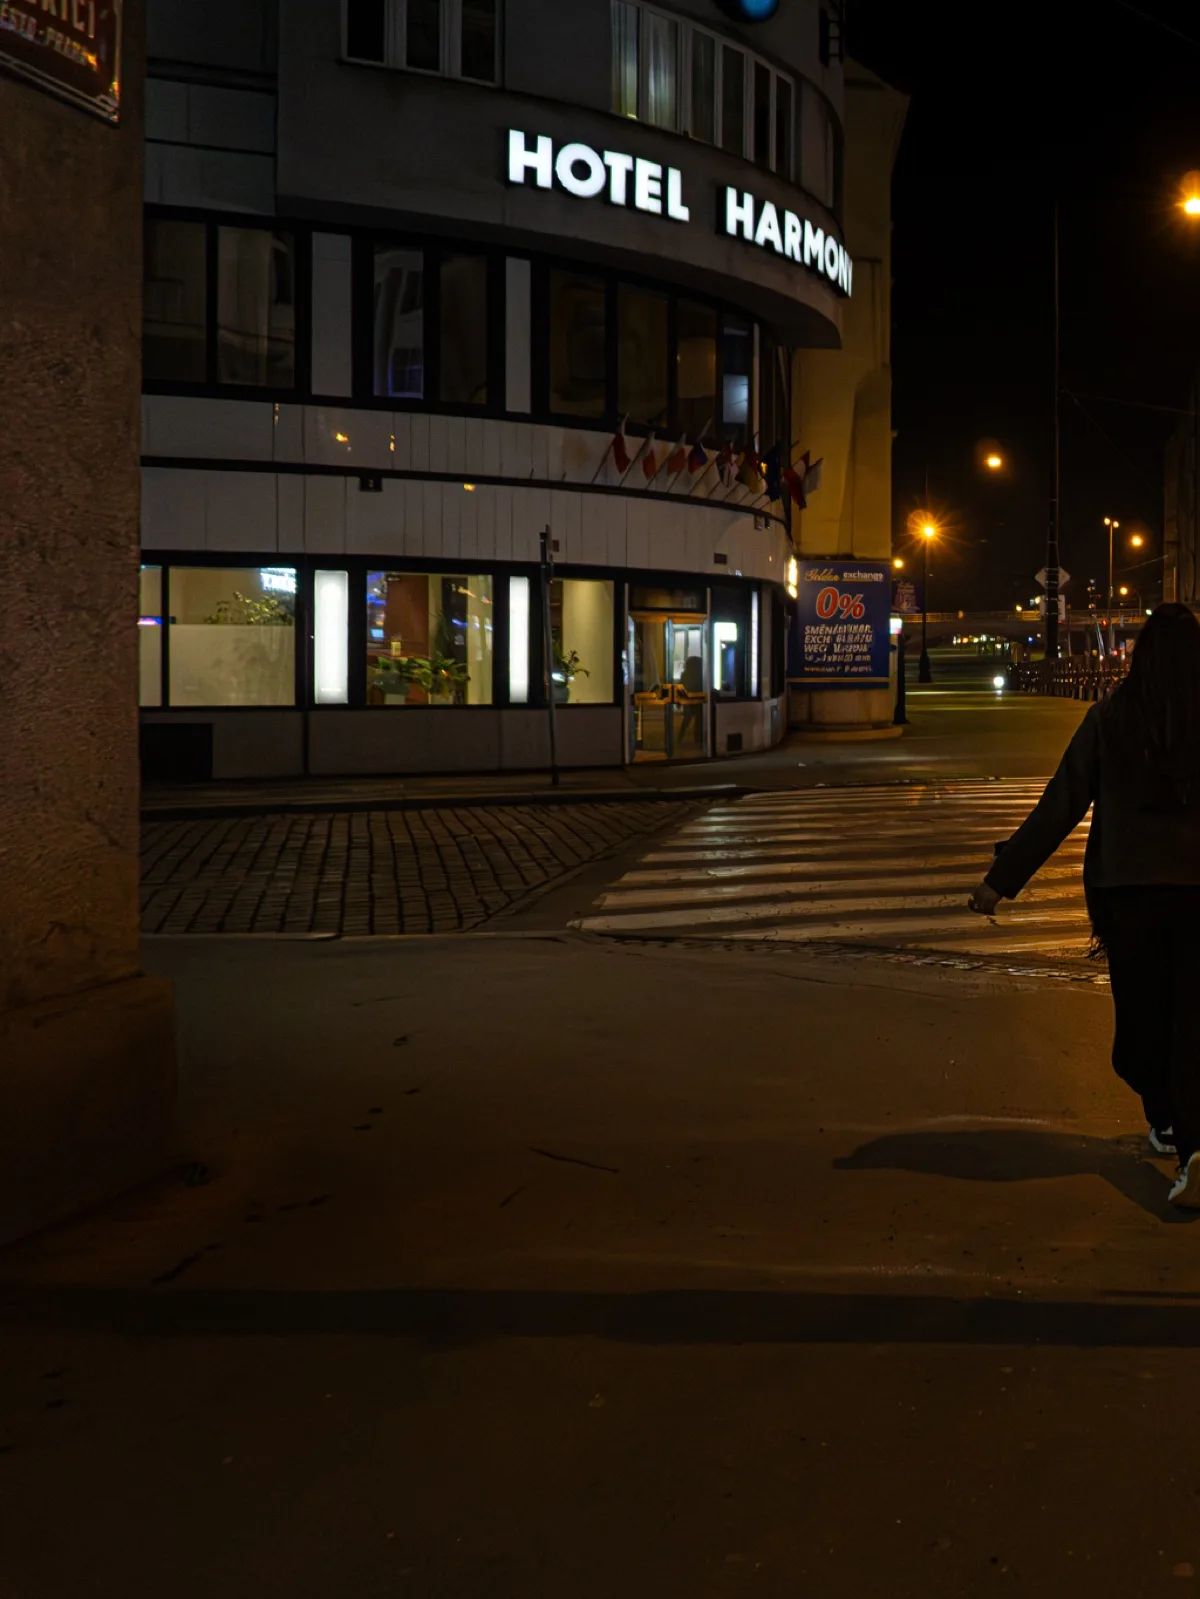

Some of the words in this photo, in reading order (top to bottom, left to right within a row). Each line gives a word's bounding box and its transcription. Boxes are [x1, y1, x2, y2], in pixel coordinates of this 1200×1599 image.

[508, 128, 690, 222] HOTEL
[725, 185, 853, 298] HARMONY
[843, 570, 884, 581] exchange
[816, 586, 866, 619] 0%
